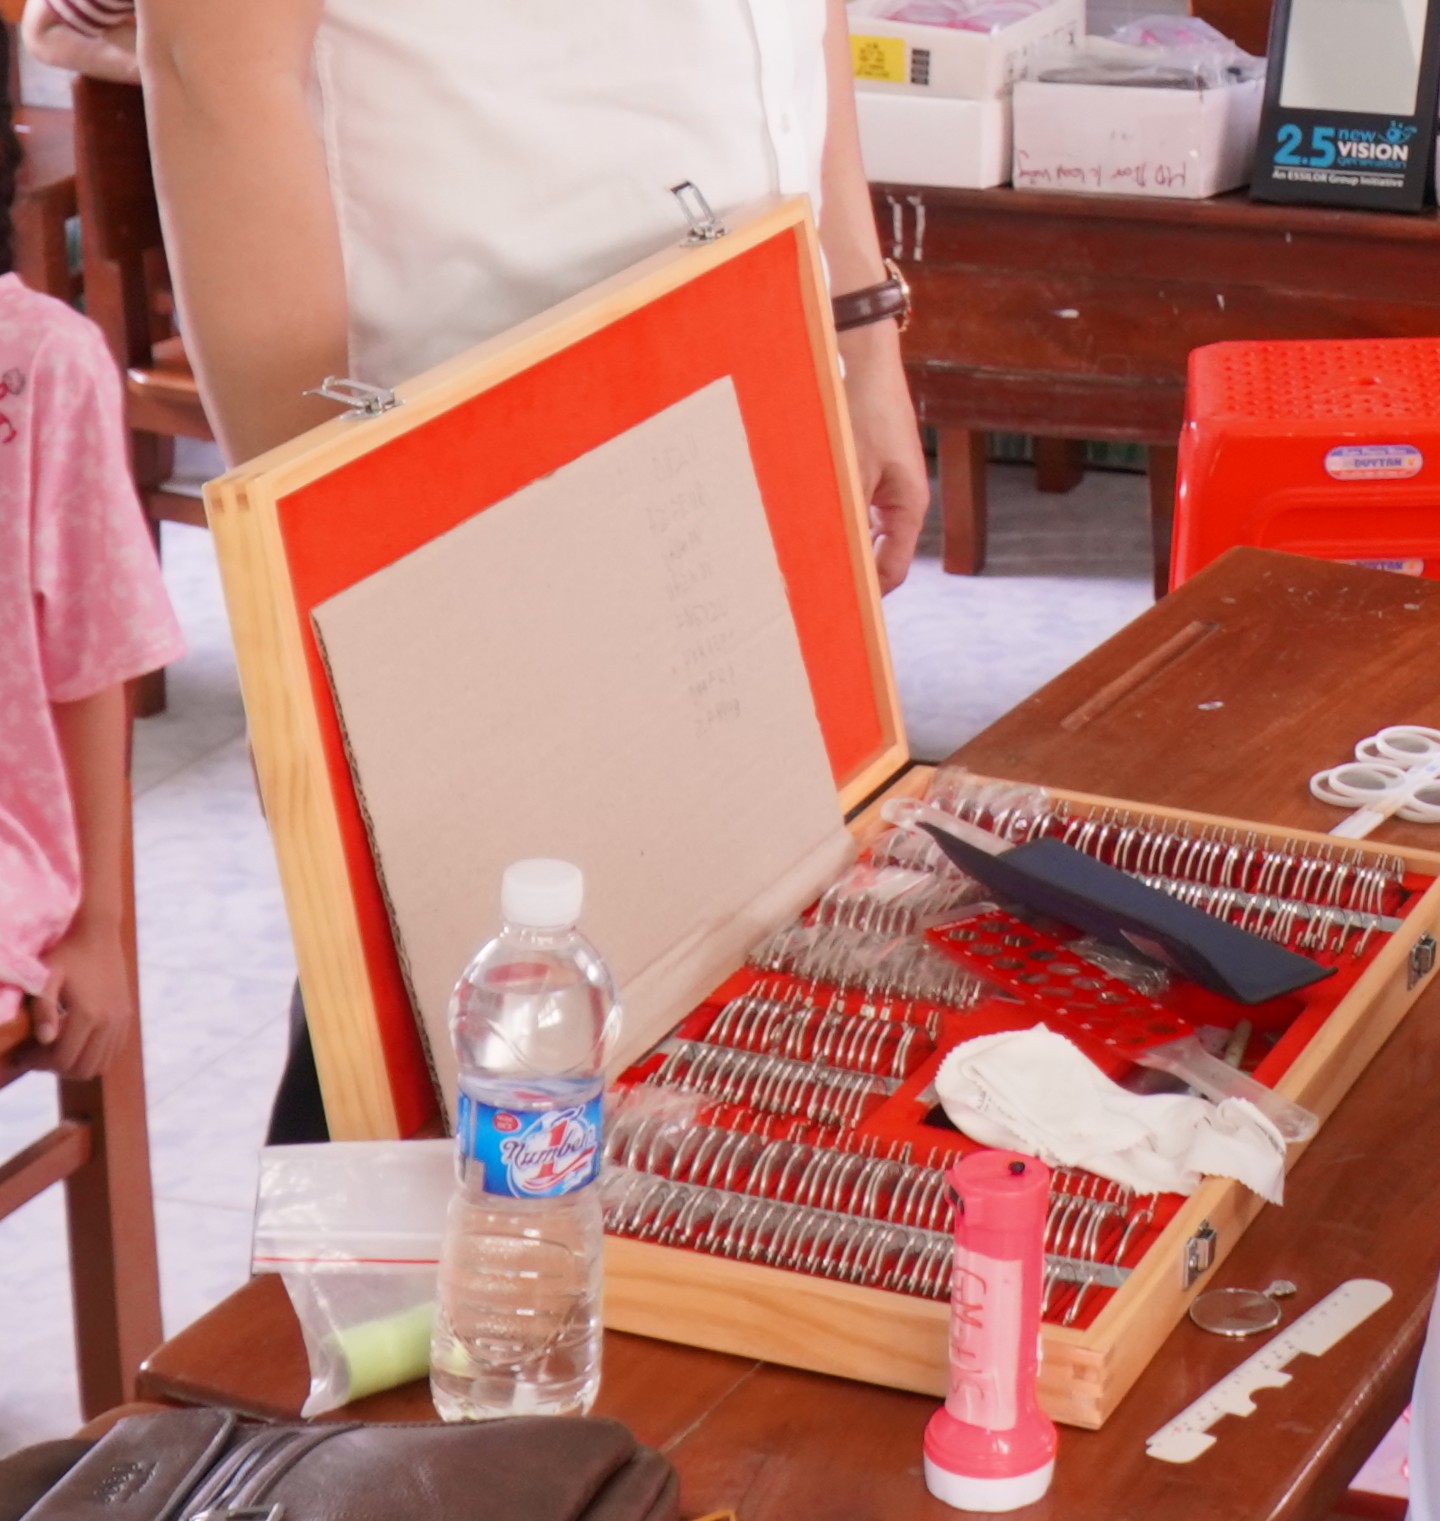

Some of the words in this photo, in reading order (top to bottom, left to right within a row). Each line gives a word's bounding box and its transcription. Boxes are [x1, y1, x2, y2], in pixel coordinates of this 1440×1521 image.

[1273, 123, 1337, 168] 2.5
[1337, 129, 1377, 142] new
[1337, 140, 1410, 162] VISION
